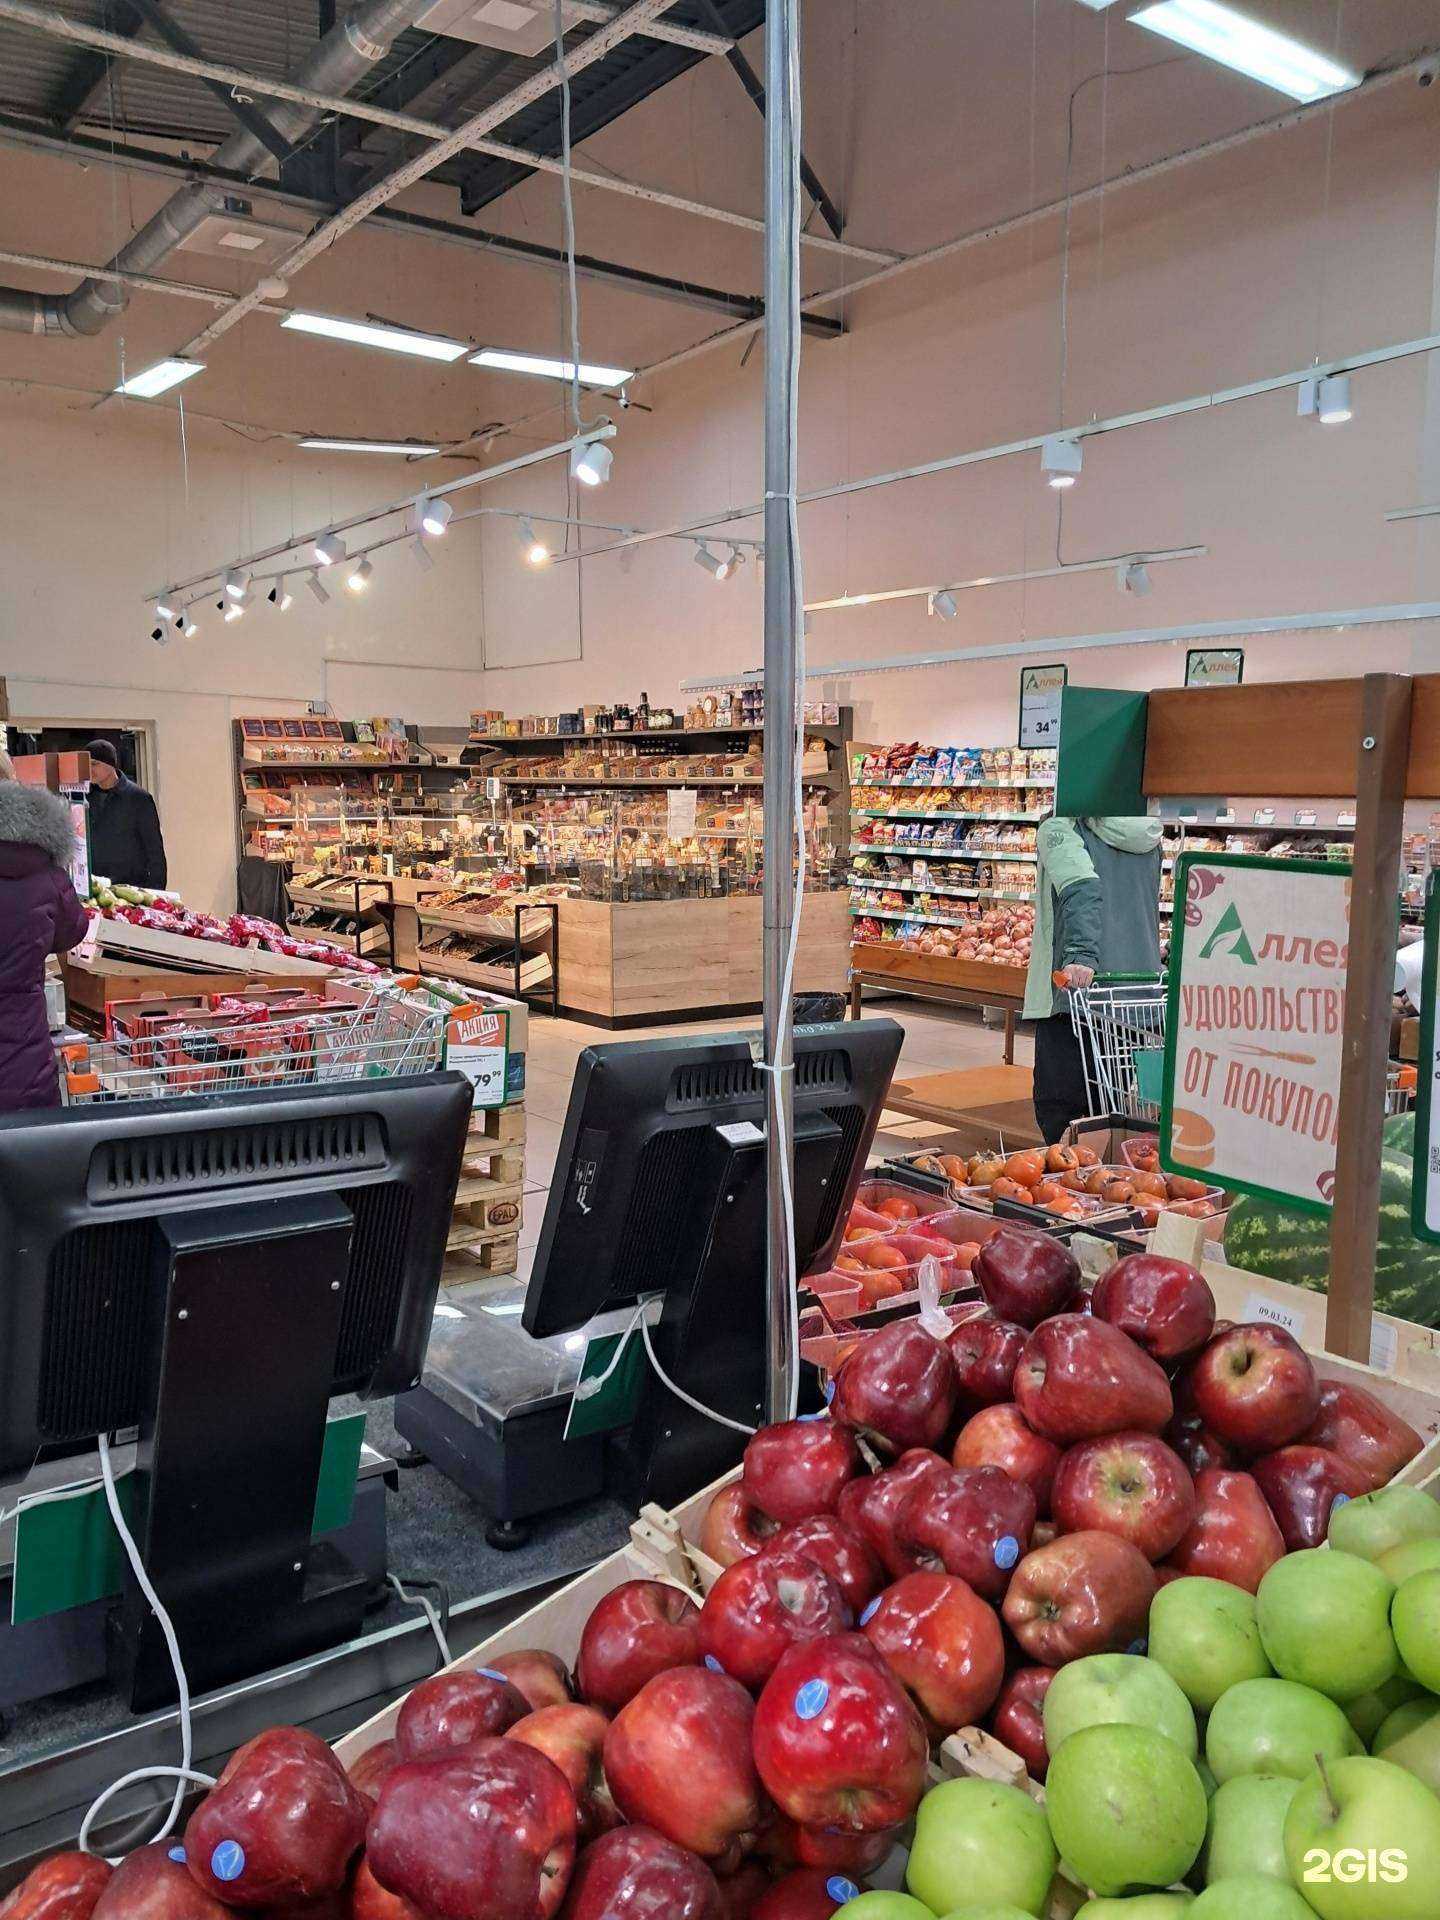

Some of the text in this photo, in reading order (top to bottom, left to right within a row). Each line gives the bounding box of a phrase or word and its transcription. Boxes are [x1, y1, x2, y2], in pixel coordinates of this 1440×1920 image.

[1035, 721, 1050, 734] 34
[462, 1015, 497, 1038] АКЦИЯ
[473, 1073, 491, 1088] 79
[1183, 1046, 1218, 1098] ОТ
[1258, 1306, 1293, 1328] 09.03.24
